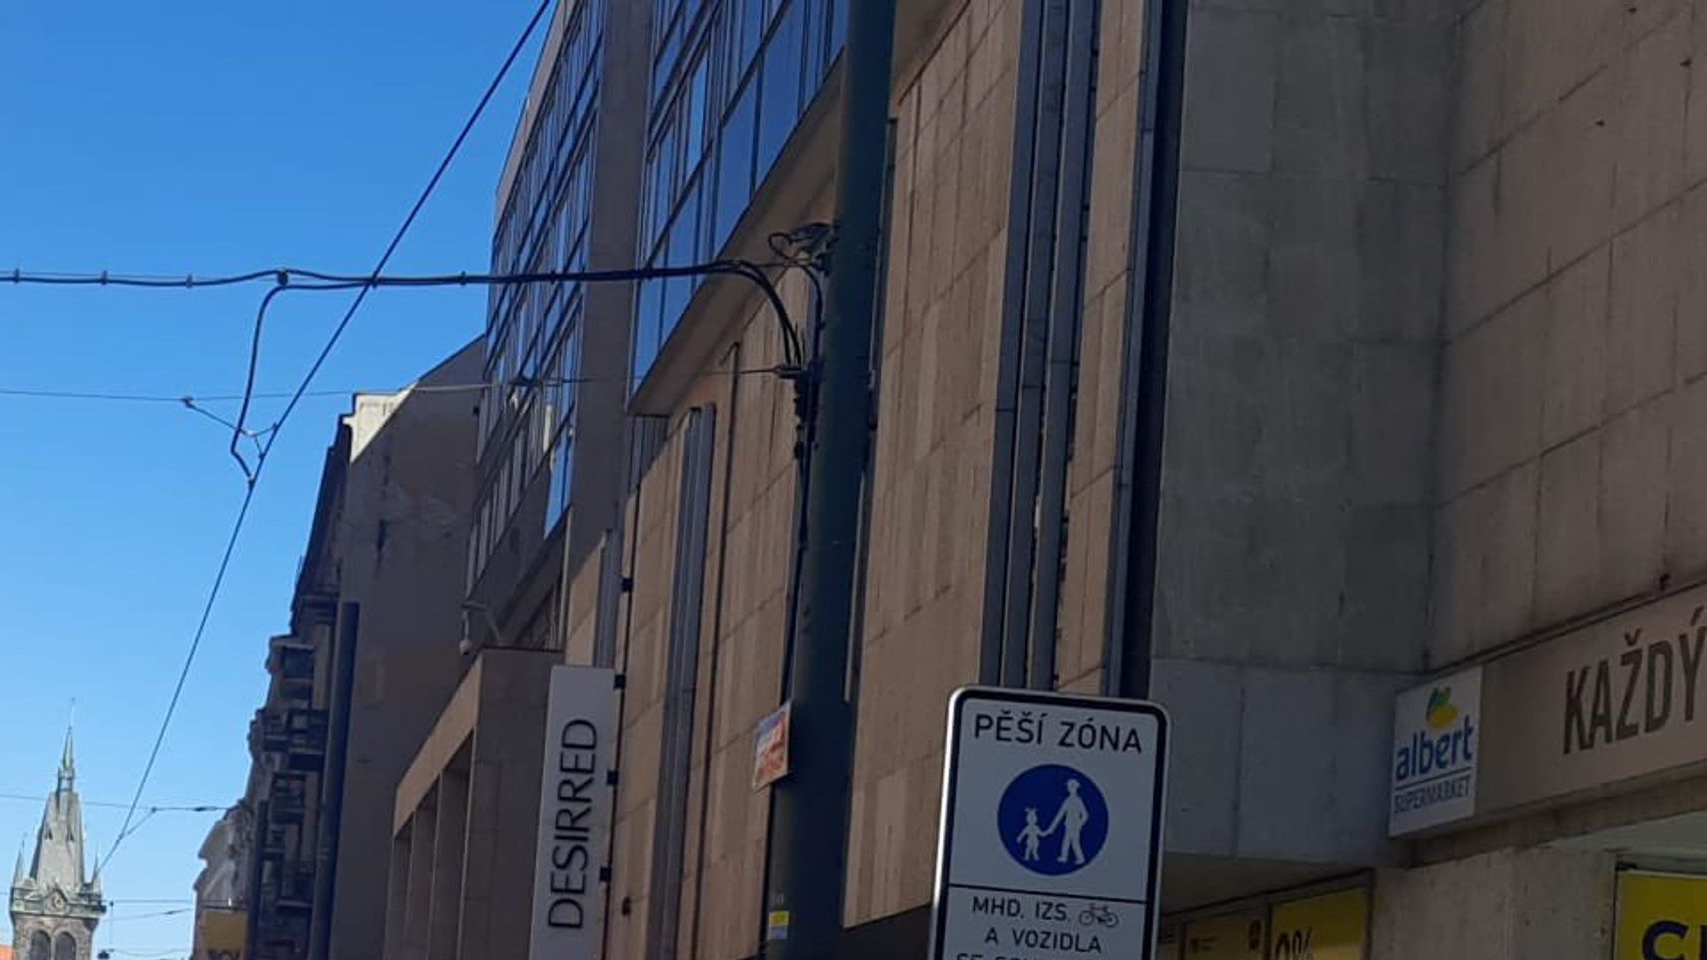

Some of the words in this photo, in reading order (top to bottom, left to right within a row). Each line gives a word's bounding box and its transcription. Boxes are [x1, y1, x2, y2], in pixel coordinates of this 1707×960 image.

[1563, 605, 1707, 755] KAŽDÝ
[974, 708, 1047, 744] PĚŠÍ
[1059, 717, 1143, 753] ZÓNA
[1396, 714, 1474, 781] albert
[1394, 774, 1471, 814] SUPERMARKET
[547, 718, 598, 930] DESIRRED
[985, 927, 999, 945] A
[1012, 929, 1102, 953] VOZIDLA
